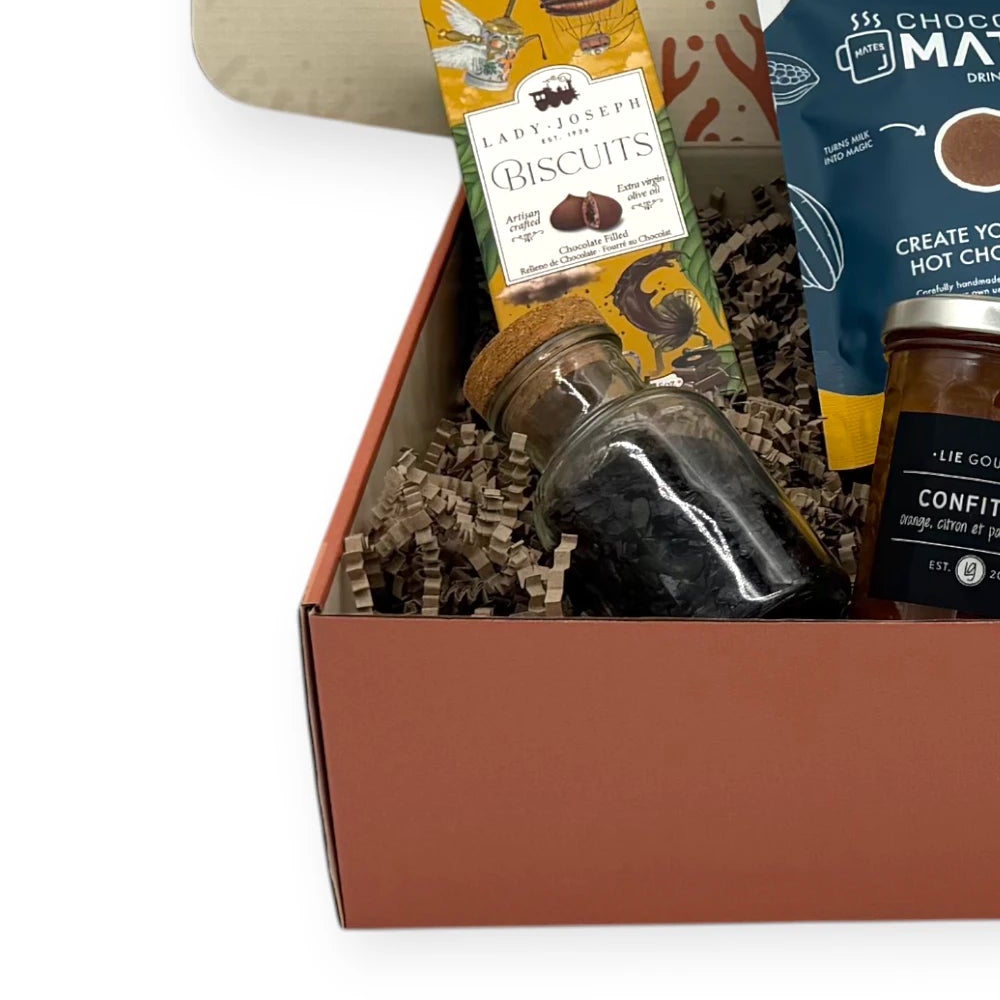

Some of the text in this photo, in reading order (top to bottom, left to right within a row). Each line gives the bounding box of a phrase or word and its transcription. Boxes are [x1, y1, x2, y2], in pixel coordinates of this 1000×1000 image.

[854, 42, 885, 59] MATES
[824, 130, 870, 155] TURNS MILK
[824, 139, 873, 165] INTO MAGIC
[491, 132, 653, 191] BISCUITS
[617, 182, 640, 193] Extra
[628, 191, 647, 201] olive
[506, 210, 540, 224] Artisan
[510, 215, 541, 232] crafted
[559, 229, 629, 254] Chocolate Filled
[560, 249, 597, 263] Chocolate
[638, 229, 672, 242] Chocolat
[896, 227, 970, 255] CREATE
[910, 252, 953, 276] HOT
[937, 518, 967, 533] citron
[971, 524, 984, 535] et
[929, 560, 951, 572] EST.
